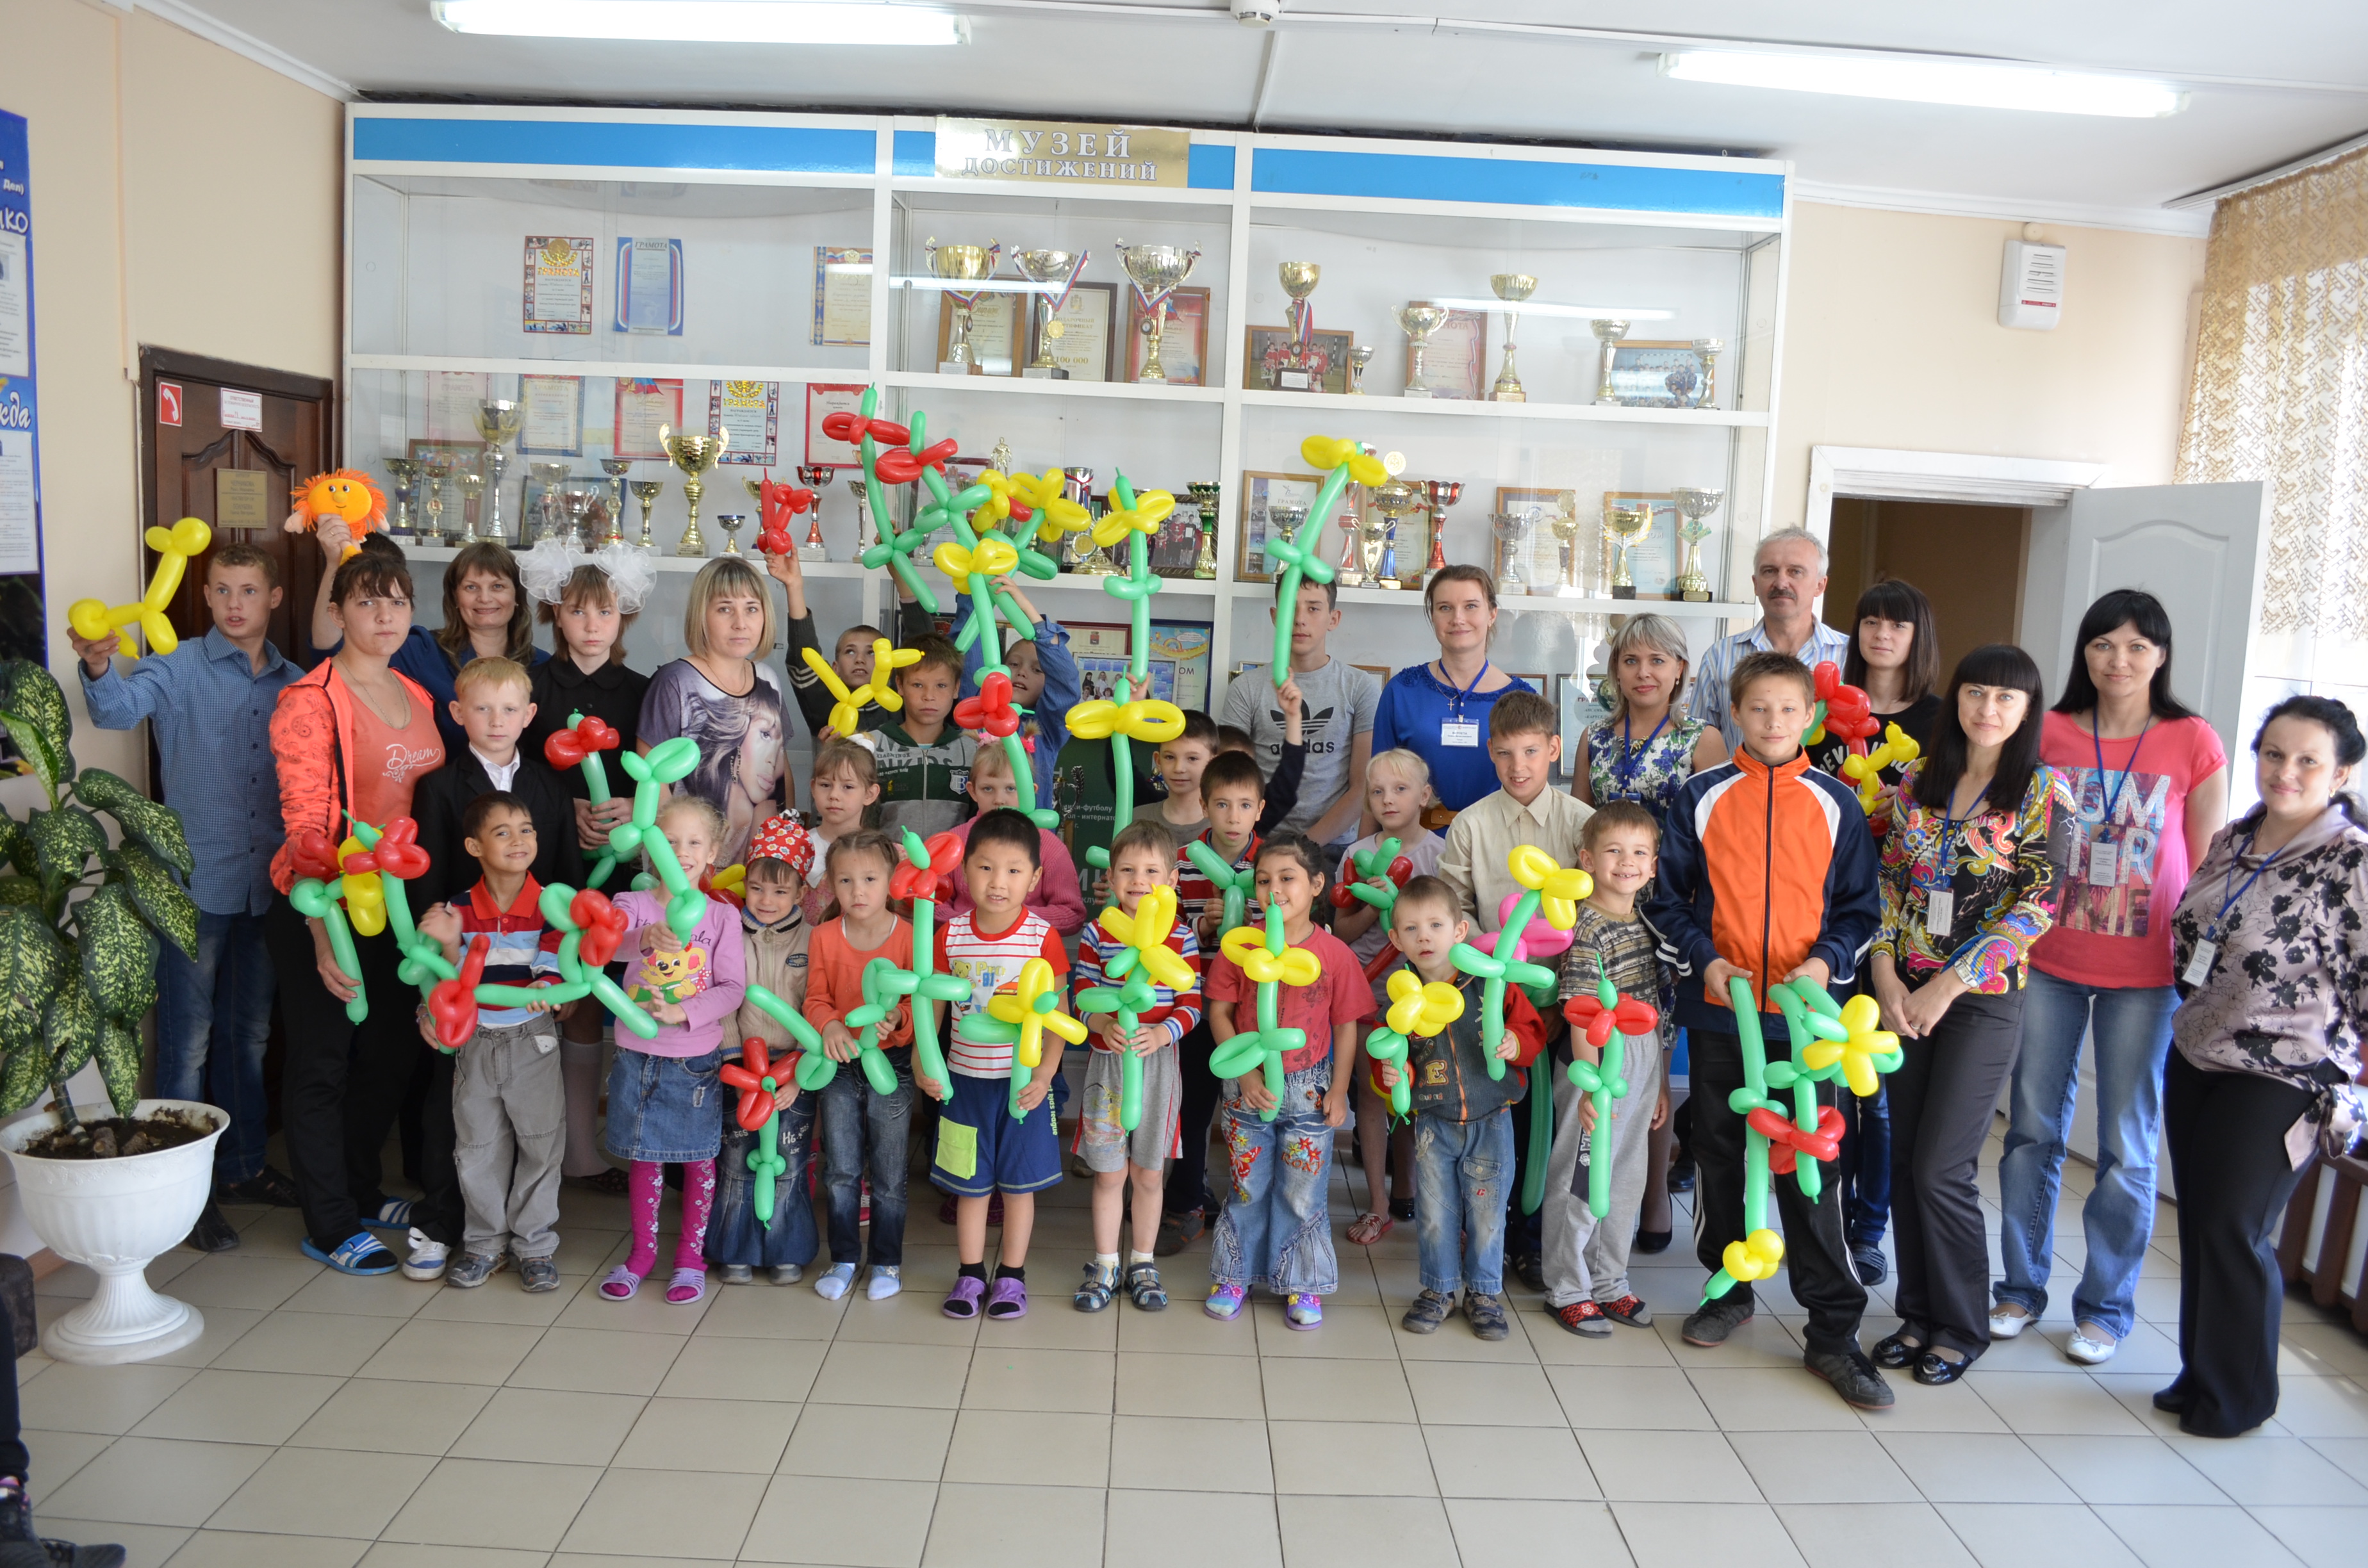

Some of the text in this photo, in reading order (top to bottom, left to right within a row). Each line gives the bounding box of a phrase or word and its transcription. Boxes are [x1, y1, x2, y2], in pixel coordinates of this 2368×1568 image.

[985, 129, 1131, 158] МУЗЕЙ
[962, 158, 1157, 181] ДОСТИЖЕНИЙ
[537, 266, 580, 277] ГРАМОТА
[723, 398, 766, 409] ГРАМОТА
[386, 744, 441, 770] Dream
[2075, 767, 2171, 829] UM
[976, 961, 1006, 977] Pro
[1281, 1152, 1325, 1175] ROXY
